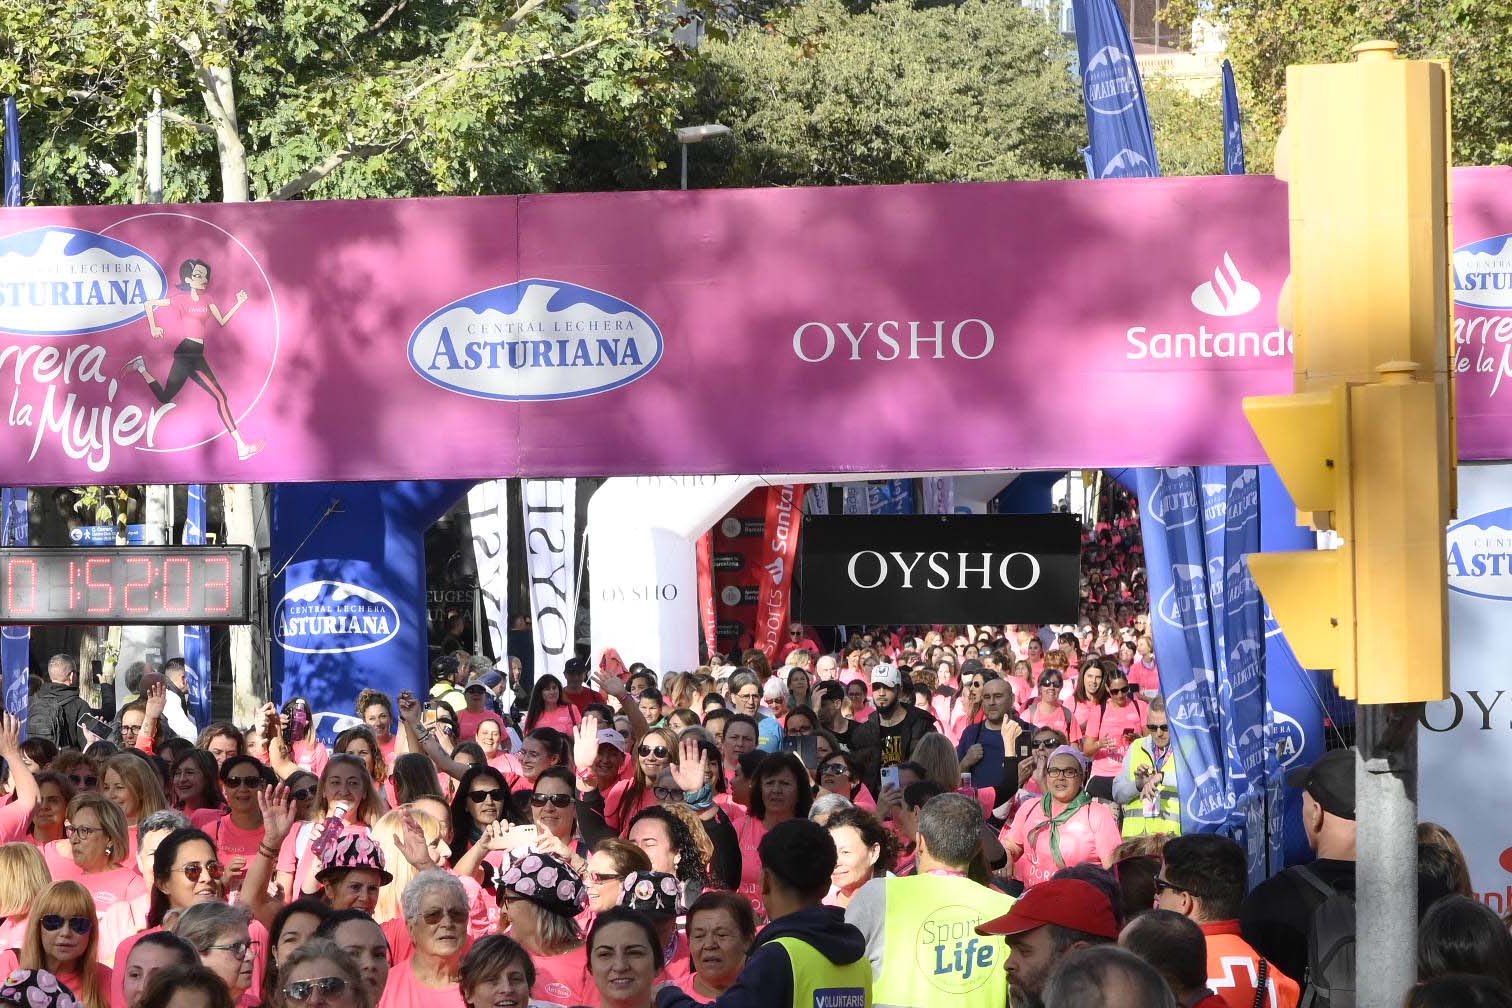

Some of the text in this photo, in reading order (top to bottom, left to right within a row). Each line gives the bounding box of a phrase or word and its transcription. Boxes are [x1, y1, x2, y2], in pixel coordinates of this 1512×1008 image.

[466, 319, 635, 336] CENTRAL LECHERA
[792, 317, 995, 363] OYSHO
[428, 325, 644, 371] ASTURIANA
[8, 387, 33, 427] la
[28, 378, 177, 473] Mujer
[8, 558, 232, 614] 01:52:03
[847, 551, 1042, 591] OYSHO
[278, 609, 391, 635] ASTURIANA
[290, 605, 386, 614] CENTRAL LECHERA
[1418, 690, 1512, 733] OY
[922, 914, 983, 946] Sport
[933, 938, 994, 979] Life
[815, 994, 865, 1008] VOLUNTARIS
